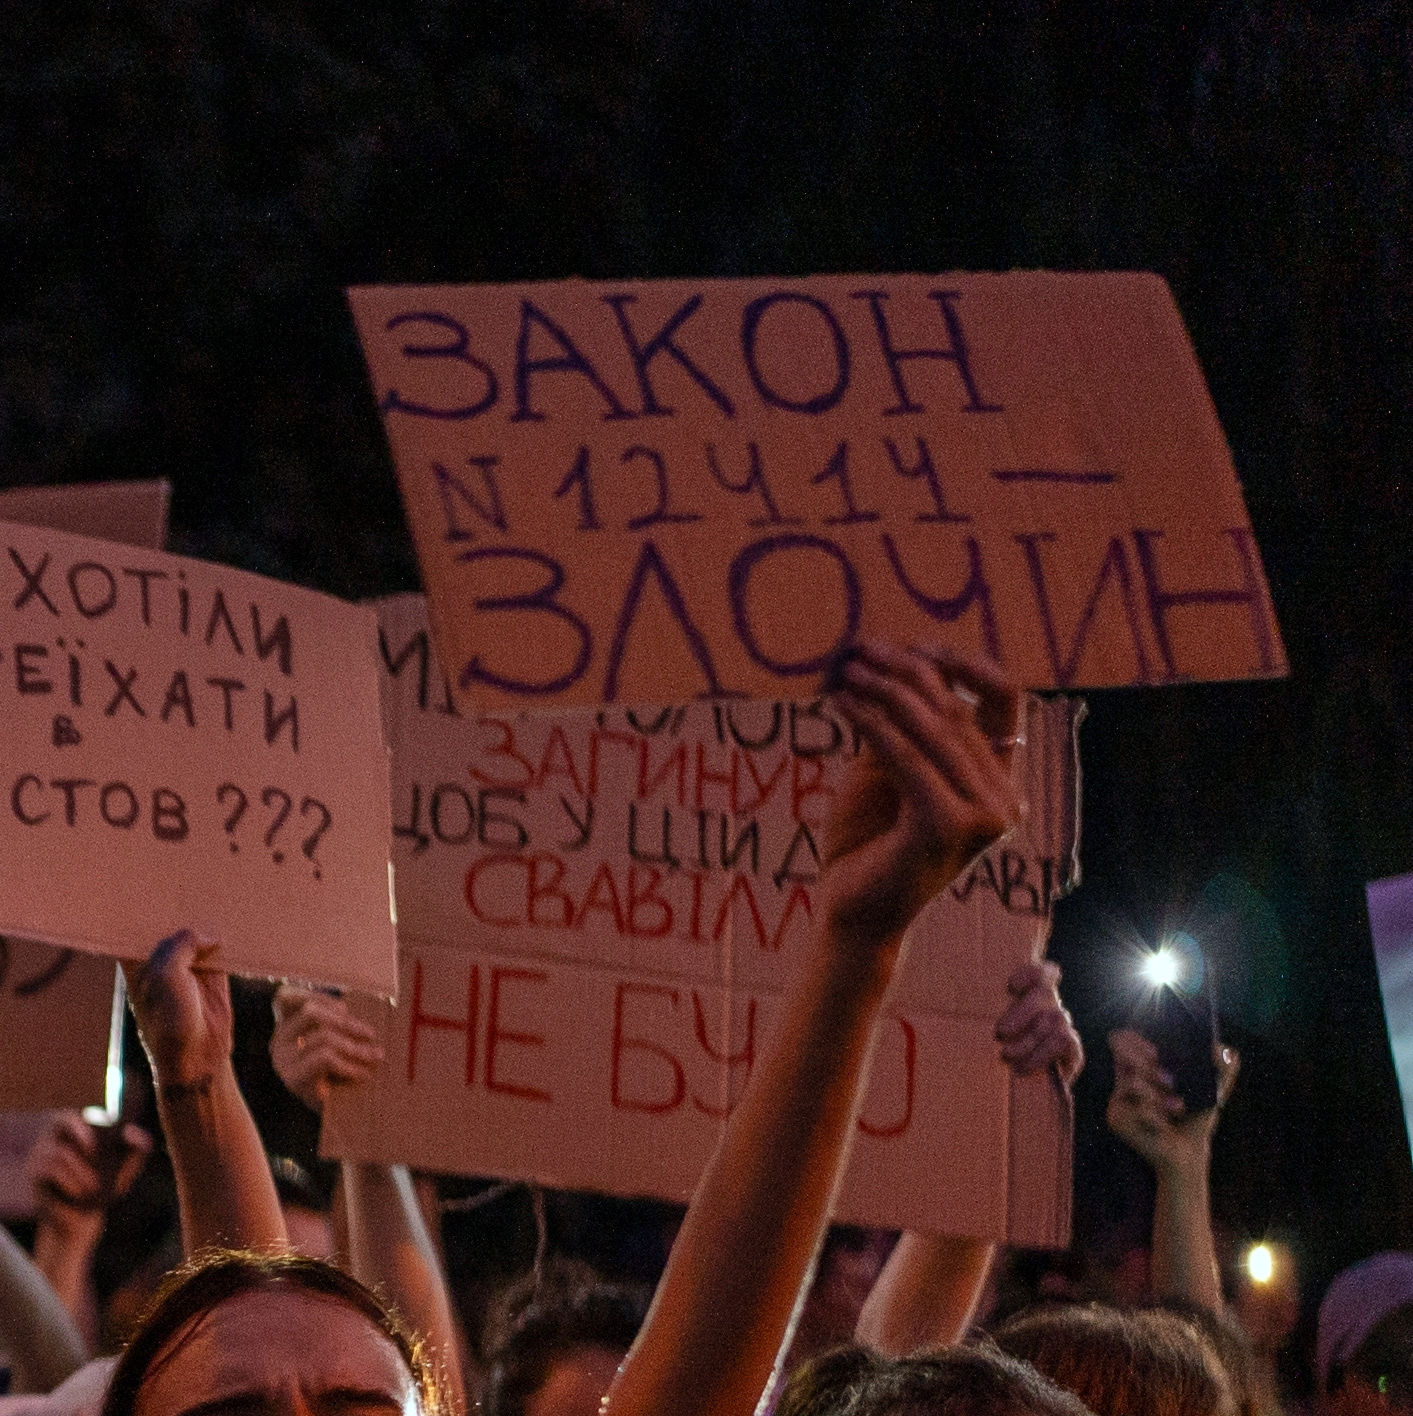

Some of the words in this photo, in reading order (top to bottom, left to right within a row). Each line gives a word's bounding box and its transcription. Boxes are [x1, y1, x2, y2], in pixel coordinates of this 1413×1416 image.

[382, 290, 1004, 422] ЗАКОН
[457, 527, 1278, 704] ЗЛОЧИН
[469, 717, 835, 829] ЗАГИНУВ
[560, 797, 594, 853] У
[465, 853, 818, 950] СВАВІЛЛ
[407, 960, 553, 1102] НЕ
[611, 981, 917, 1138] БУО
